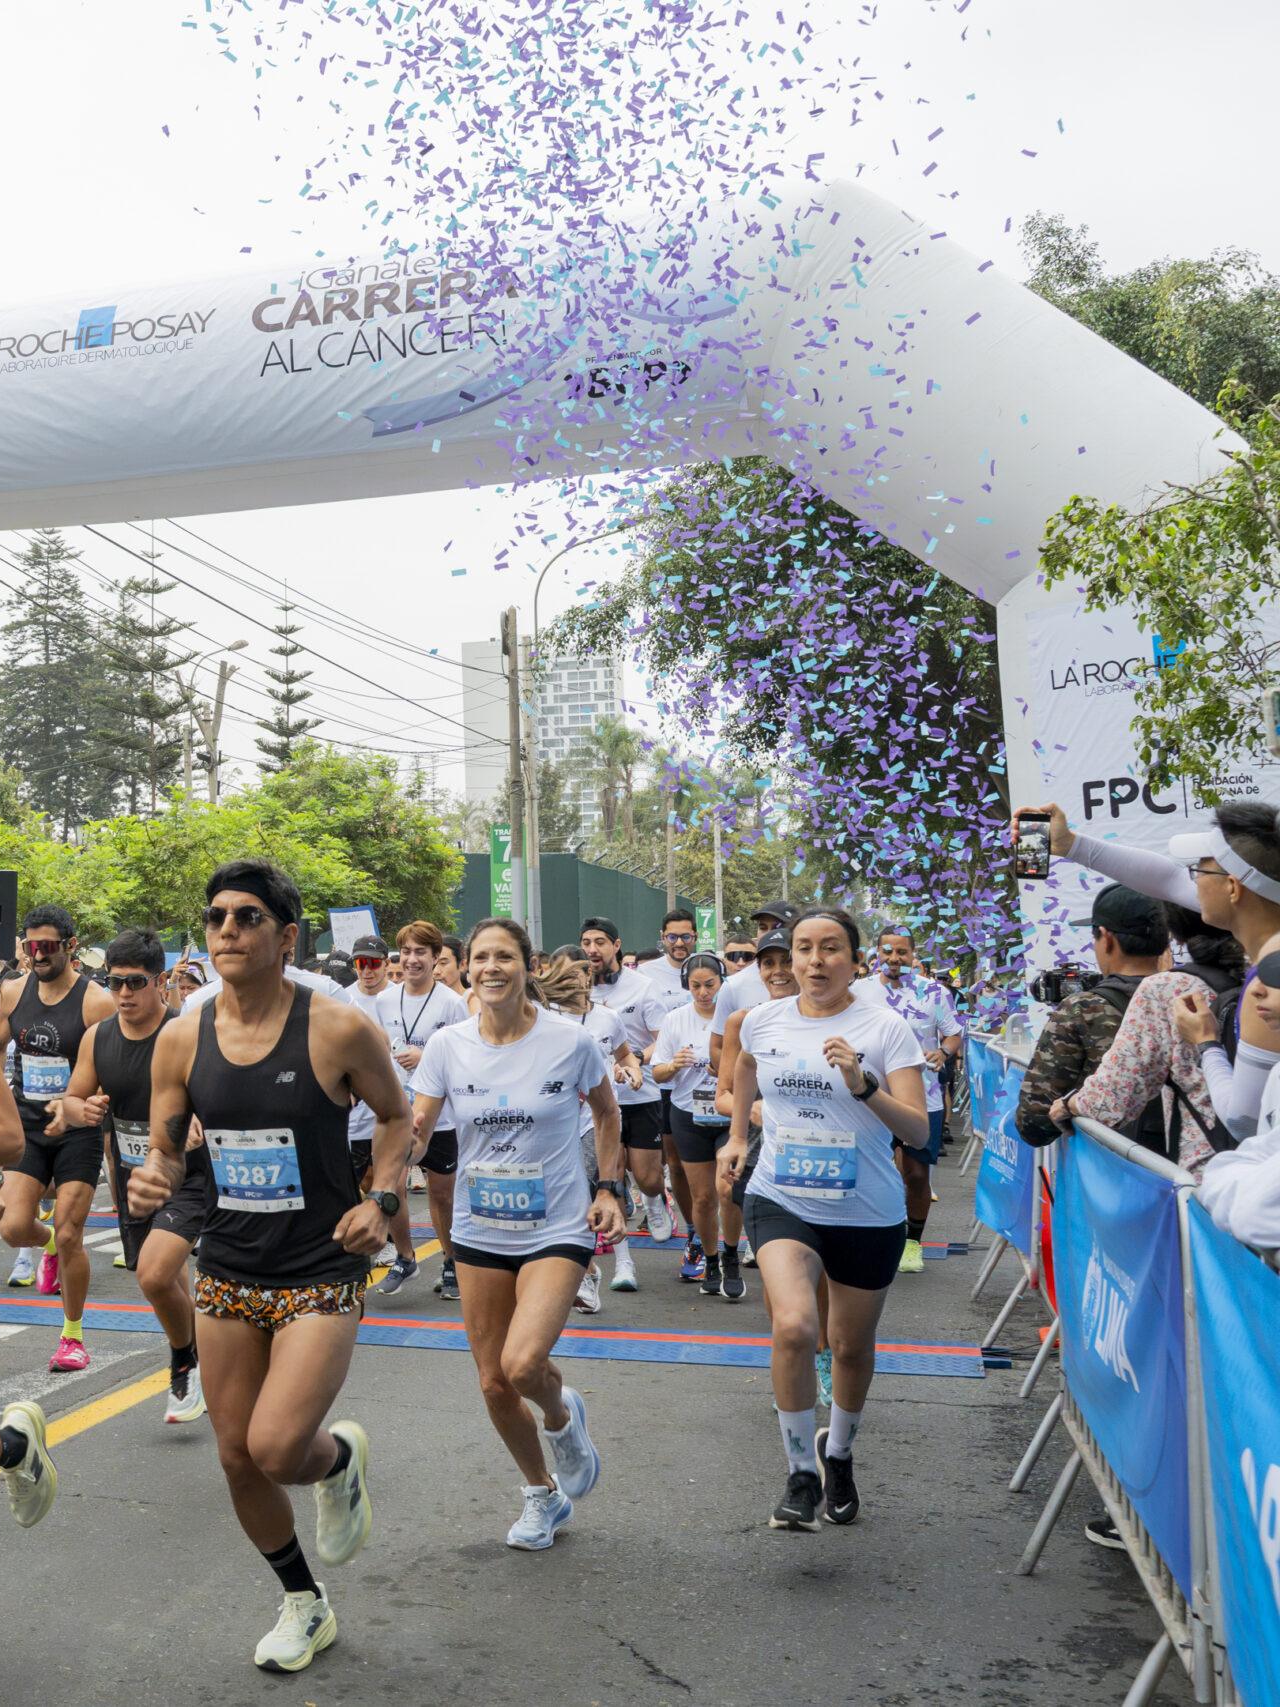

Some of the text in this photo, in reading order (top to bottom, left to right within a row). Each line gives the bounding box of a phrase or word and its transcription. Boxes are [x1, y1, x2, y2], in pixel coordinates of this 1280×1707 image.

[111, 308, 217, 342] POSAY
[77, 337, 195, 364] DERMATOLOGIQUE
[260, 338, 312, 377] AL
[1050, 666, 1081, 690] LA
[1082, 776, 1177, 821] FPC
[701, 913, 712, 928] 7
[30, 1034, 49, 1047] JR
[30, 1074, 63, 1087] 3298
[773, 1078, 834, 1092] CARRERA
[473, 1115, 535, 1127] CARRERA
[225, 1164, 281, 1186] 3287
[788, 1157, 841, 1178] 3975
[479, 1190, 530, 1210] 3010
